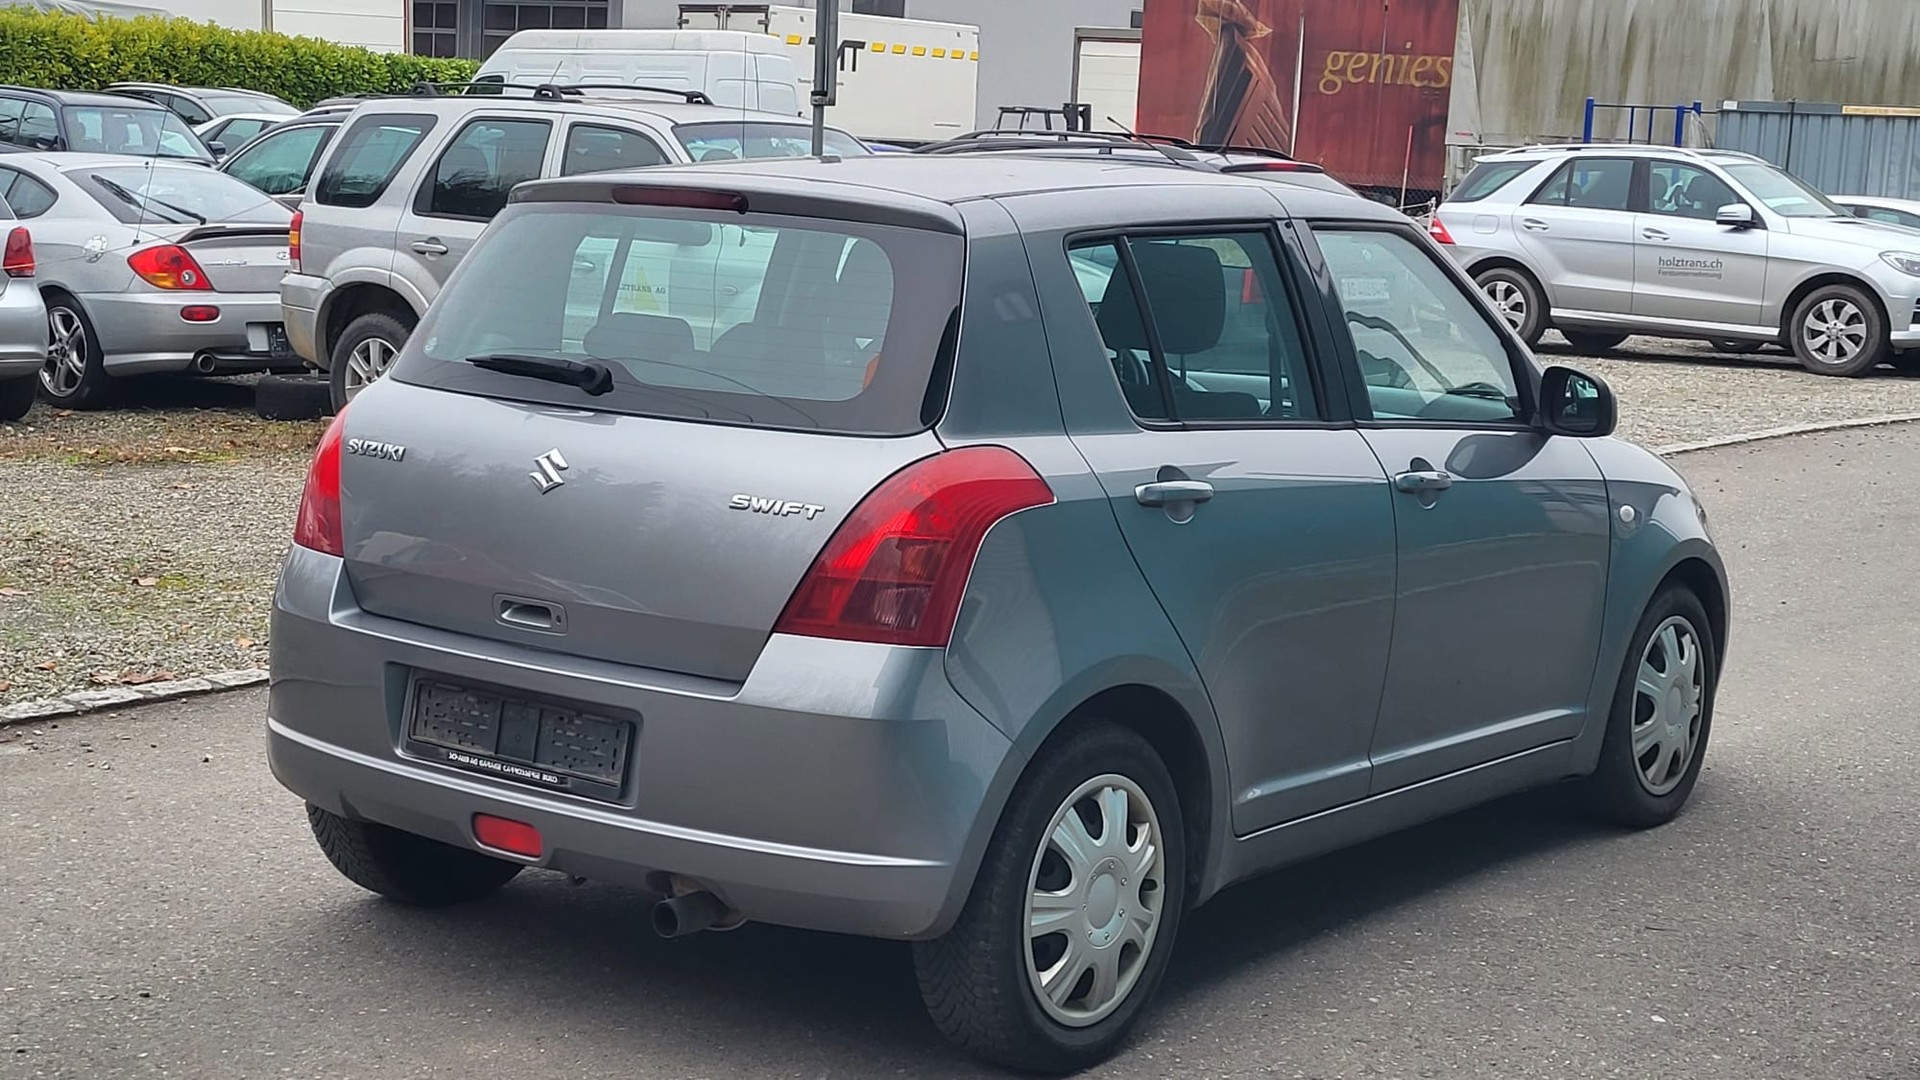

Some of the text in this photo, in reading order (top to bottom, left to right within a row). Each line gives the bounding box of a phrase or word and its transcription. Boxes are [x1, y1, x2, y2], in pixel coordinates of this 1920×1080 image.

[1319, 41, 1453, 95] genies
[1658, 256, 1723, 268] holztrans.ch
[346, 438, 406, 462] SUZUKI
[729, 494, 825, 520] SWIFT
